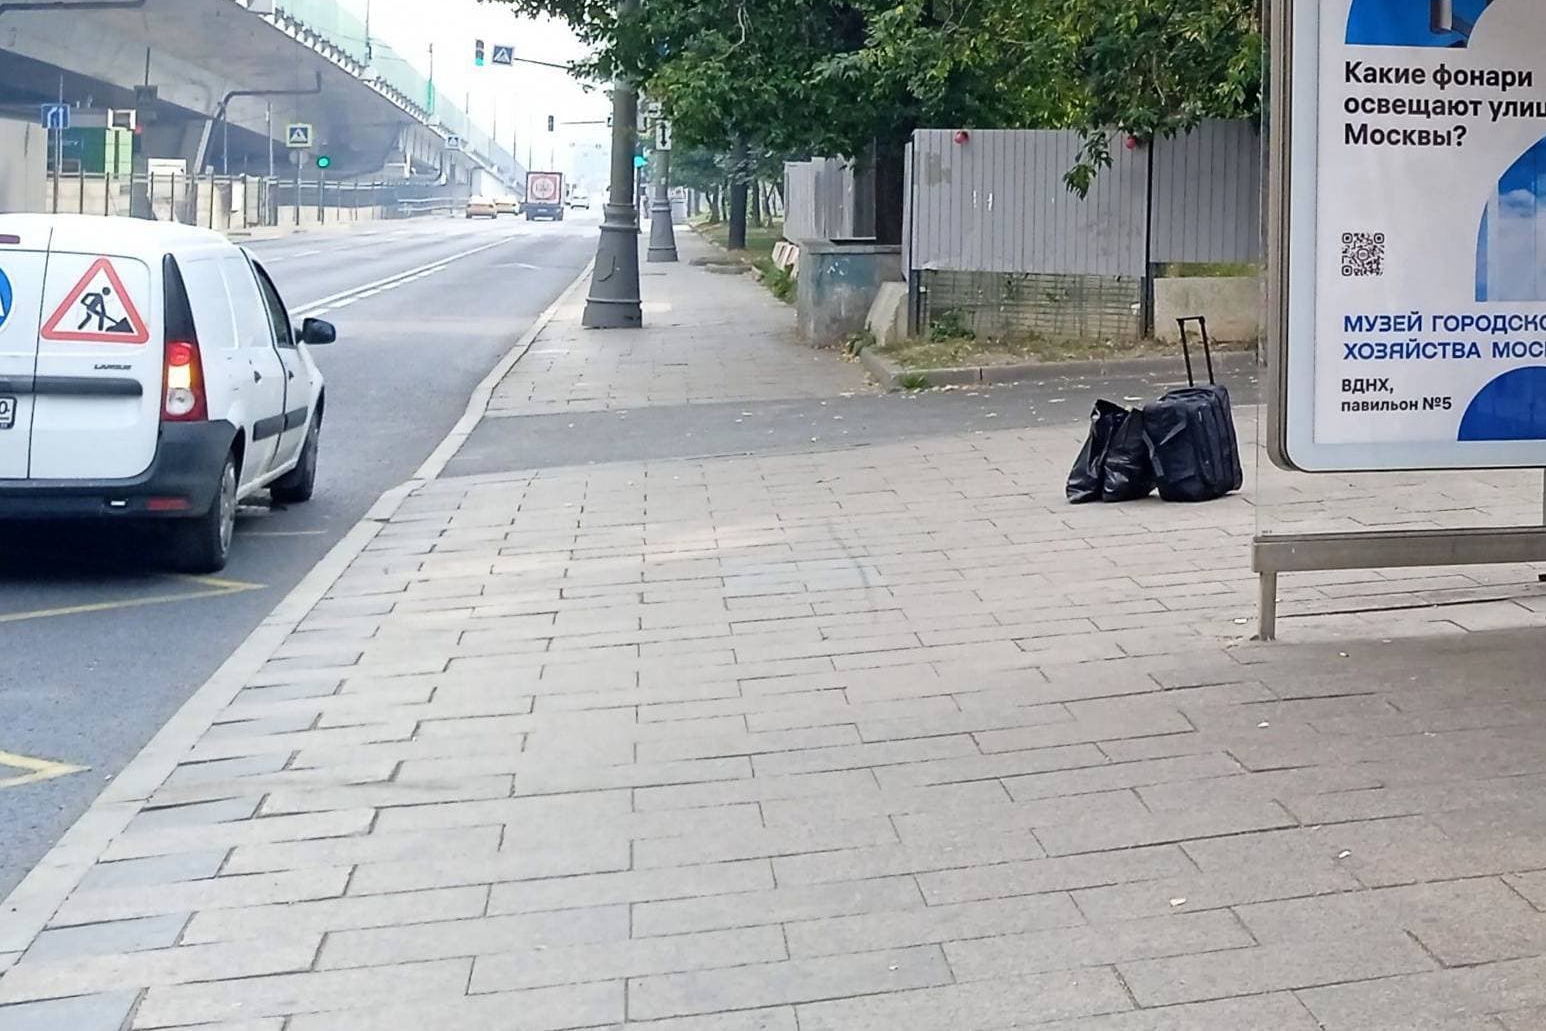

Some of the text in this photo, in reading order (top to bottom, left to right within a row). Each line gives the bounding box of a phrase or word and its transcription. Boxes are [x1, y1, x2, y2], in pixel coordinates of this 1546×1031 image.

[1344, 61, 1533, 91] Какие фонари
[1344, 95, 1483, 119] освещают
[1344, 123, 1468, 147] Москвы?
[1343, 311, 1423, 332] МУЗЕЙ
[1343, 338, 1482, 361] ХОЗЯЙСТВА
[1341, 377, 1395, 395] ВДНХ,
[1340, 396, 1452, 413] павильон №5
